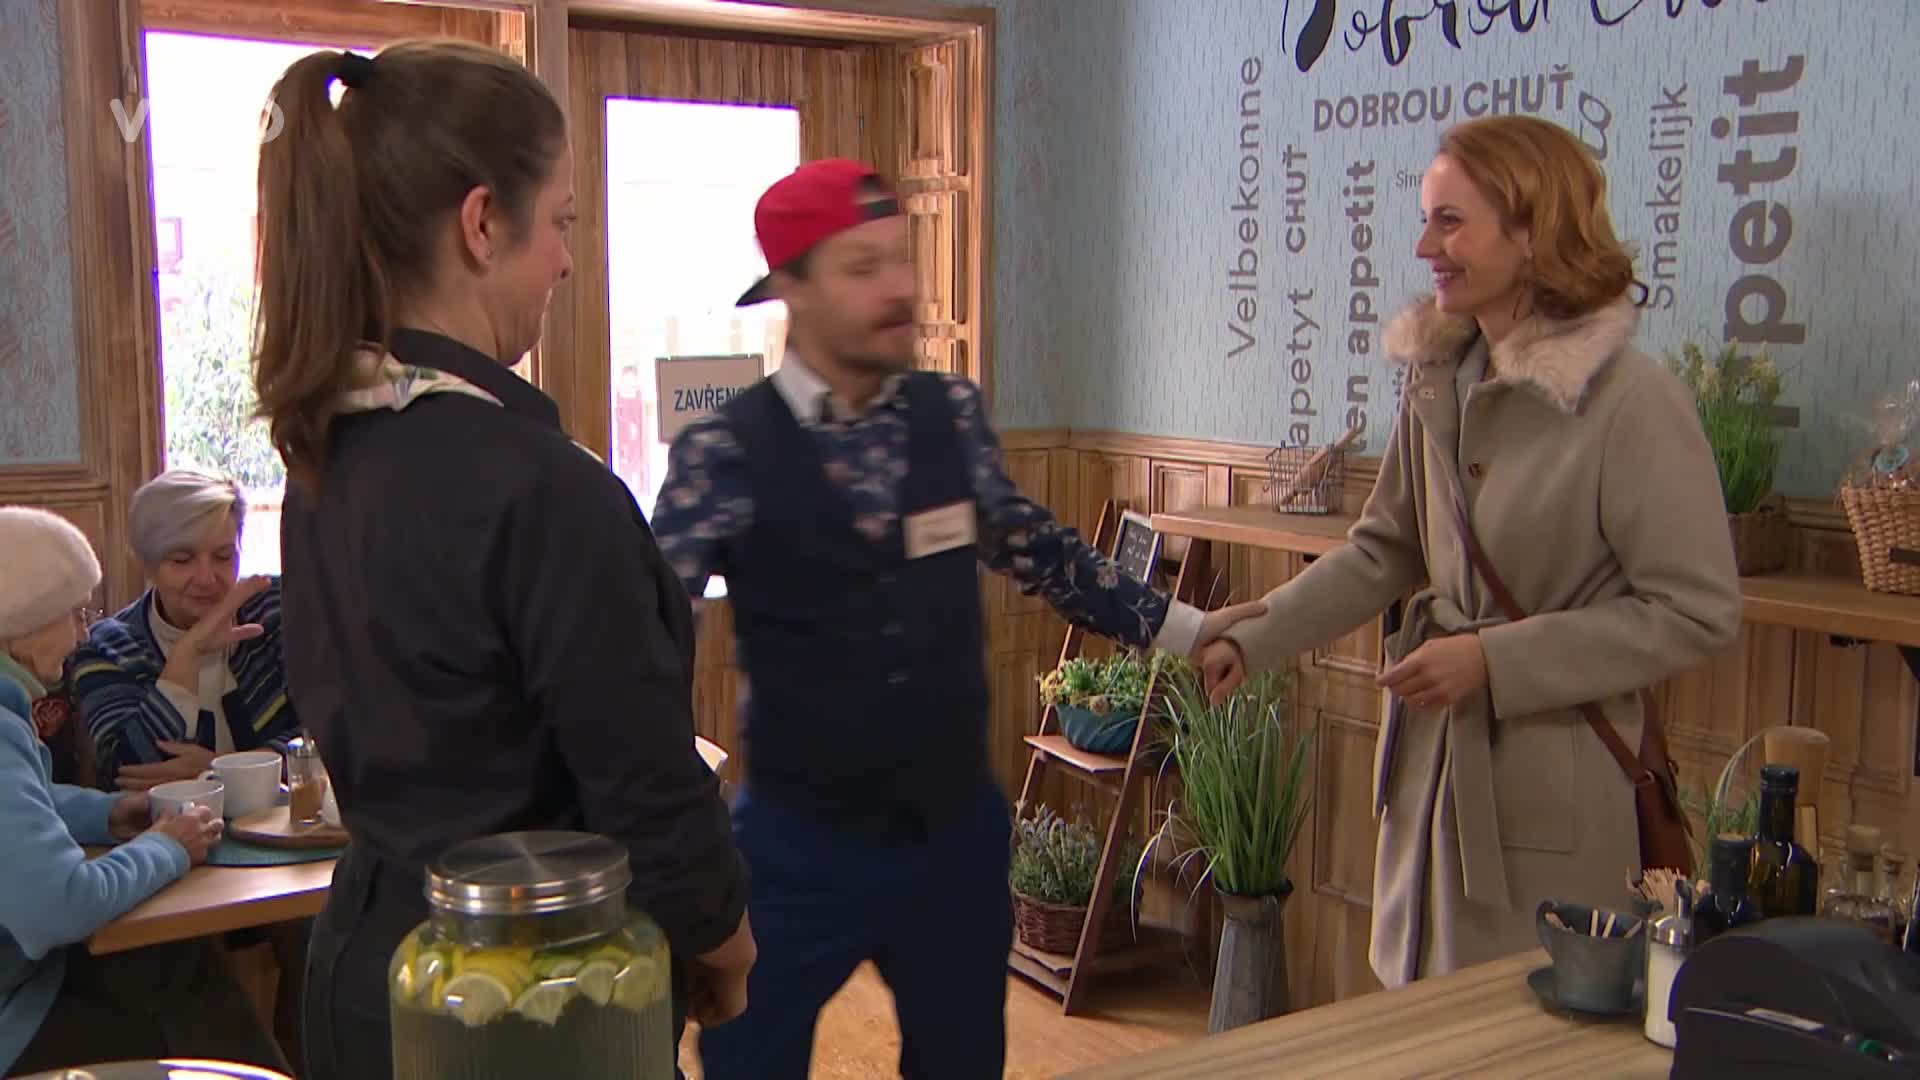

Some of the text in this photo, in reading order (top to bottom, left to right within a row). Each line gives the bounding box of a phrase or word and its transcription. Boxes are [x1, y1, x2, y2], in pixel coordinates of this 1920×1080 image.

[1313, 64, 1574, 132] DOBROU CHUŤ
[1227, 56, 1262, 358] Velbekonne
[1342, 160, 1379, 355] appetit
[1645, 83, 1692, 310] Smakelijk
[1286, 288, 1320, 446] apetyt
